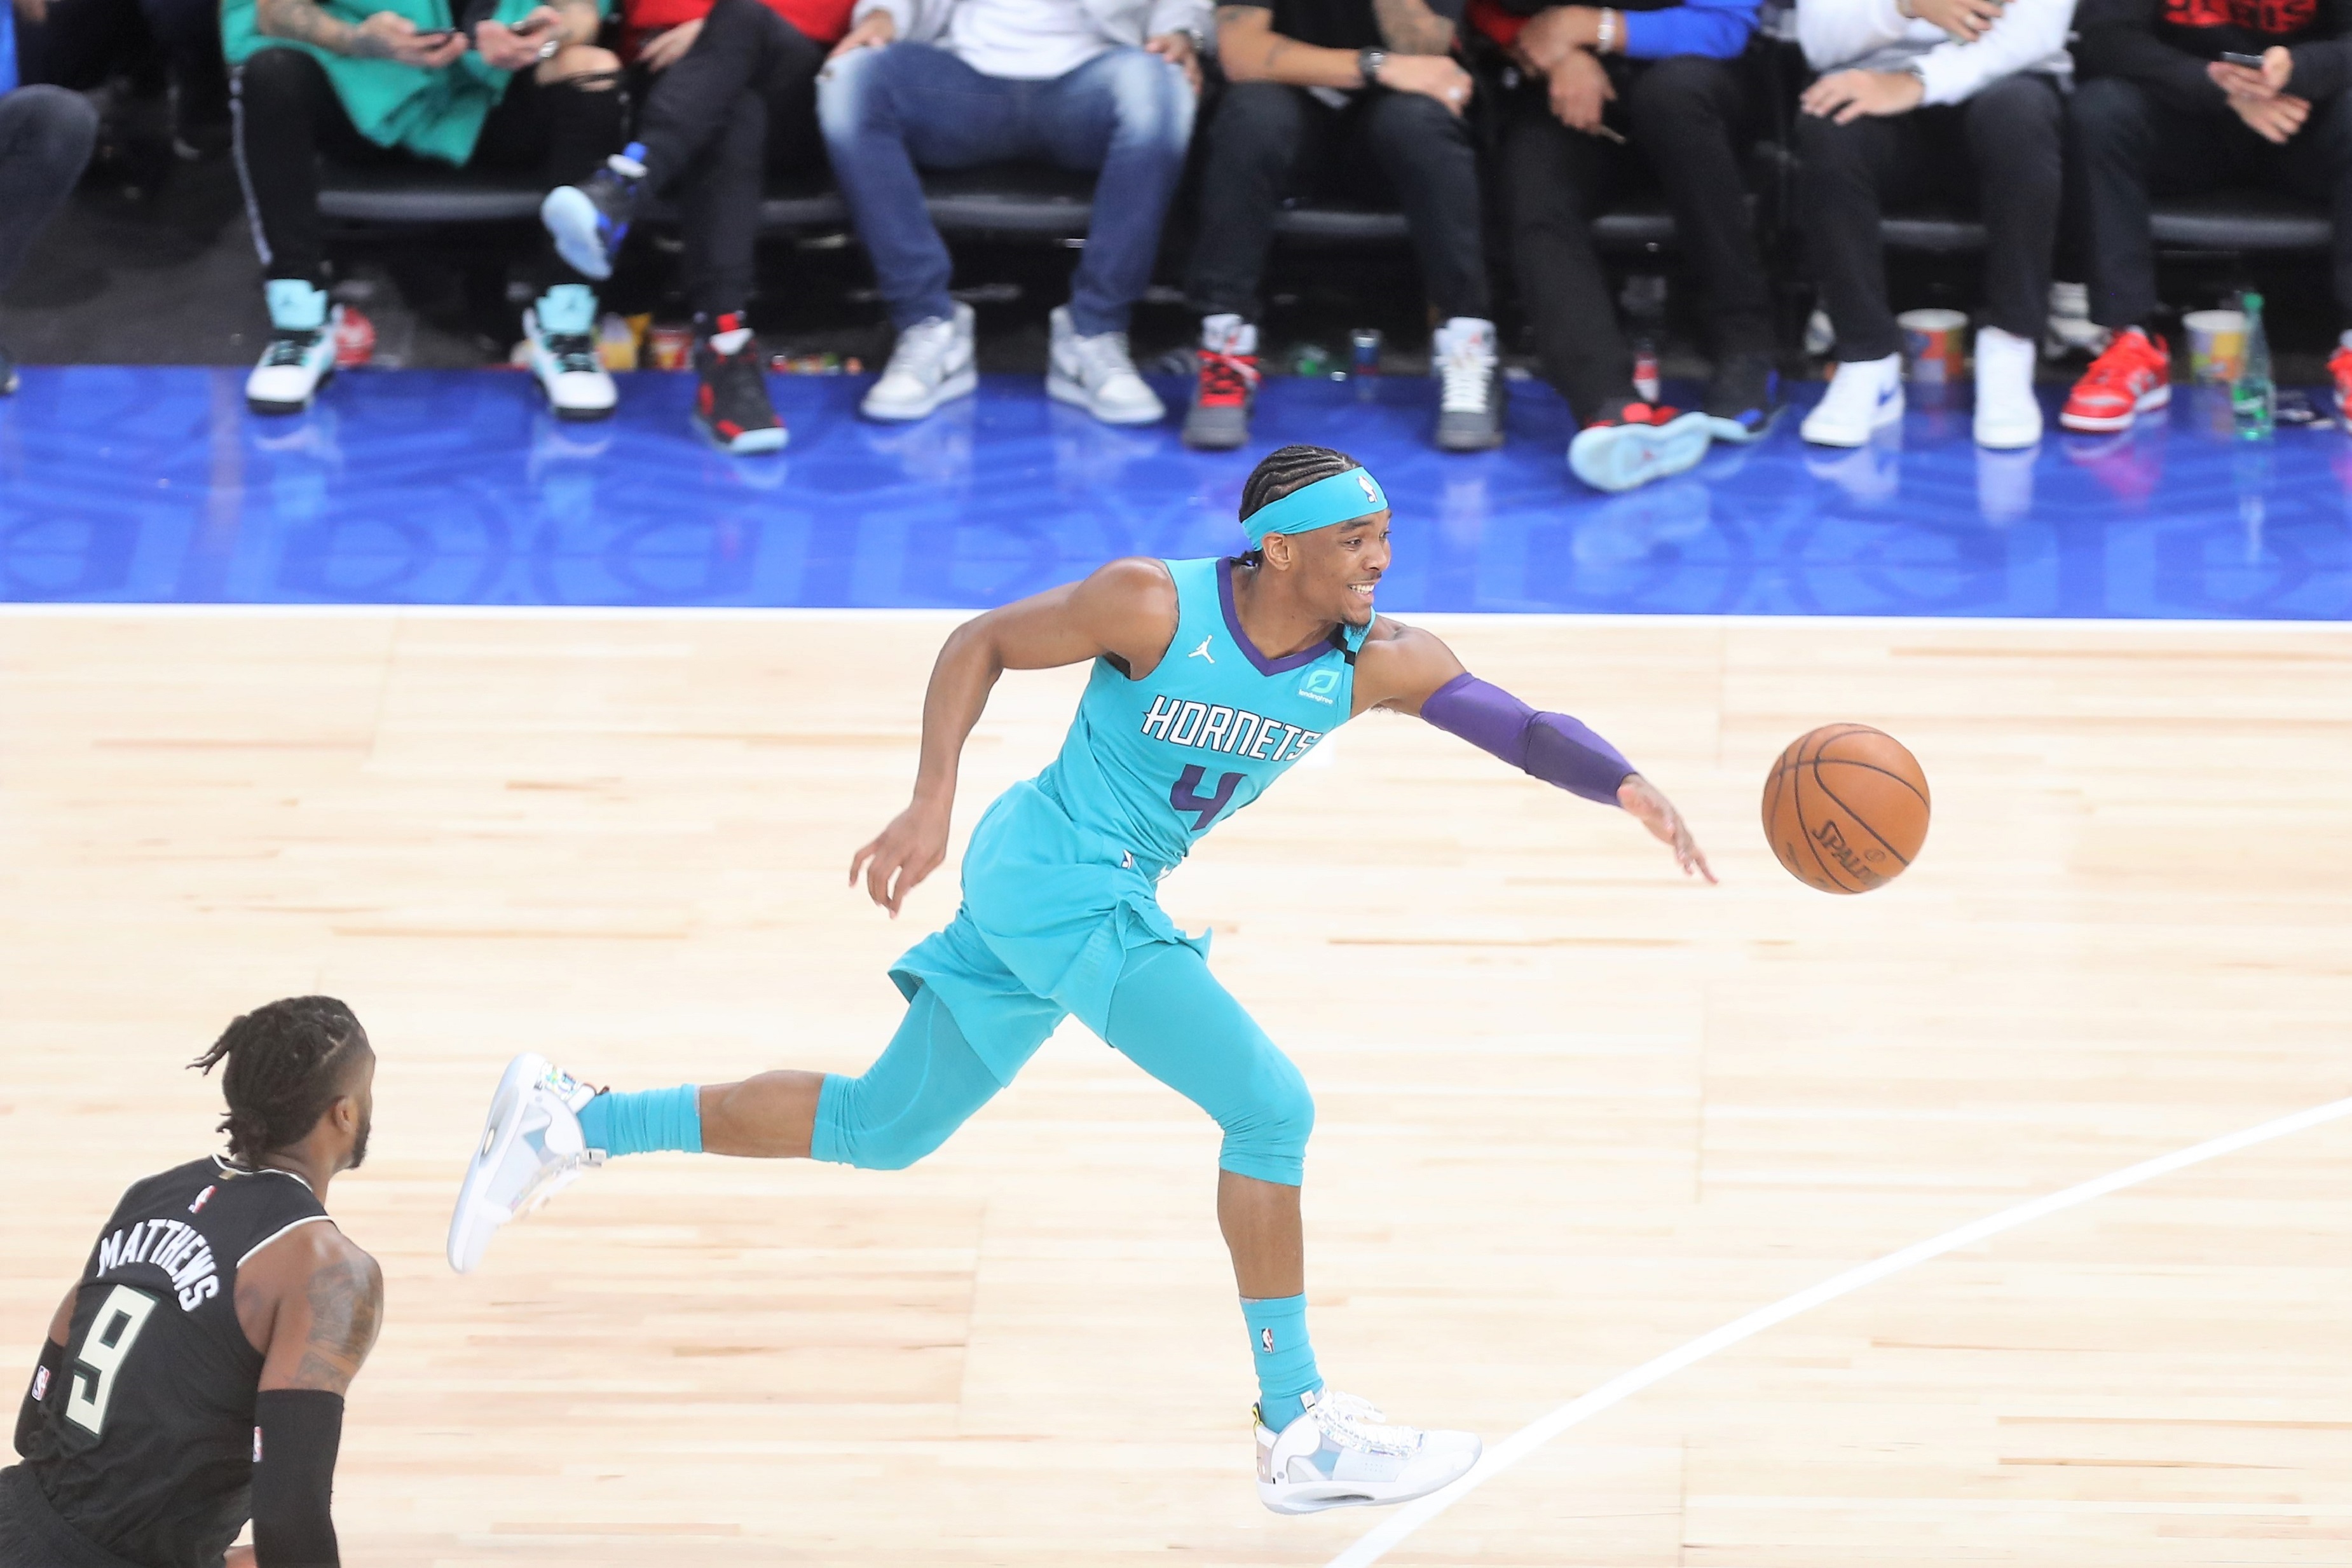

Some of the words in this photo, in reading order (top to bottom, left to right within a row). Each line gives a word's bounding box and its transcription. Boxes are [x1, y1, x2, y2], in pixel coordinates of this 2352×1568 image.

[1140, 694, 1323, 761] HORNETS
[1298, 688, 1334, 705] lendingtree
[1169, 763, 1248, 832] 4
[96, 1218, 221, 1312] MATTHEWS
[64, 1283, 161, 1438] 9
